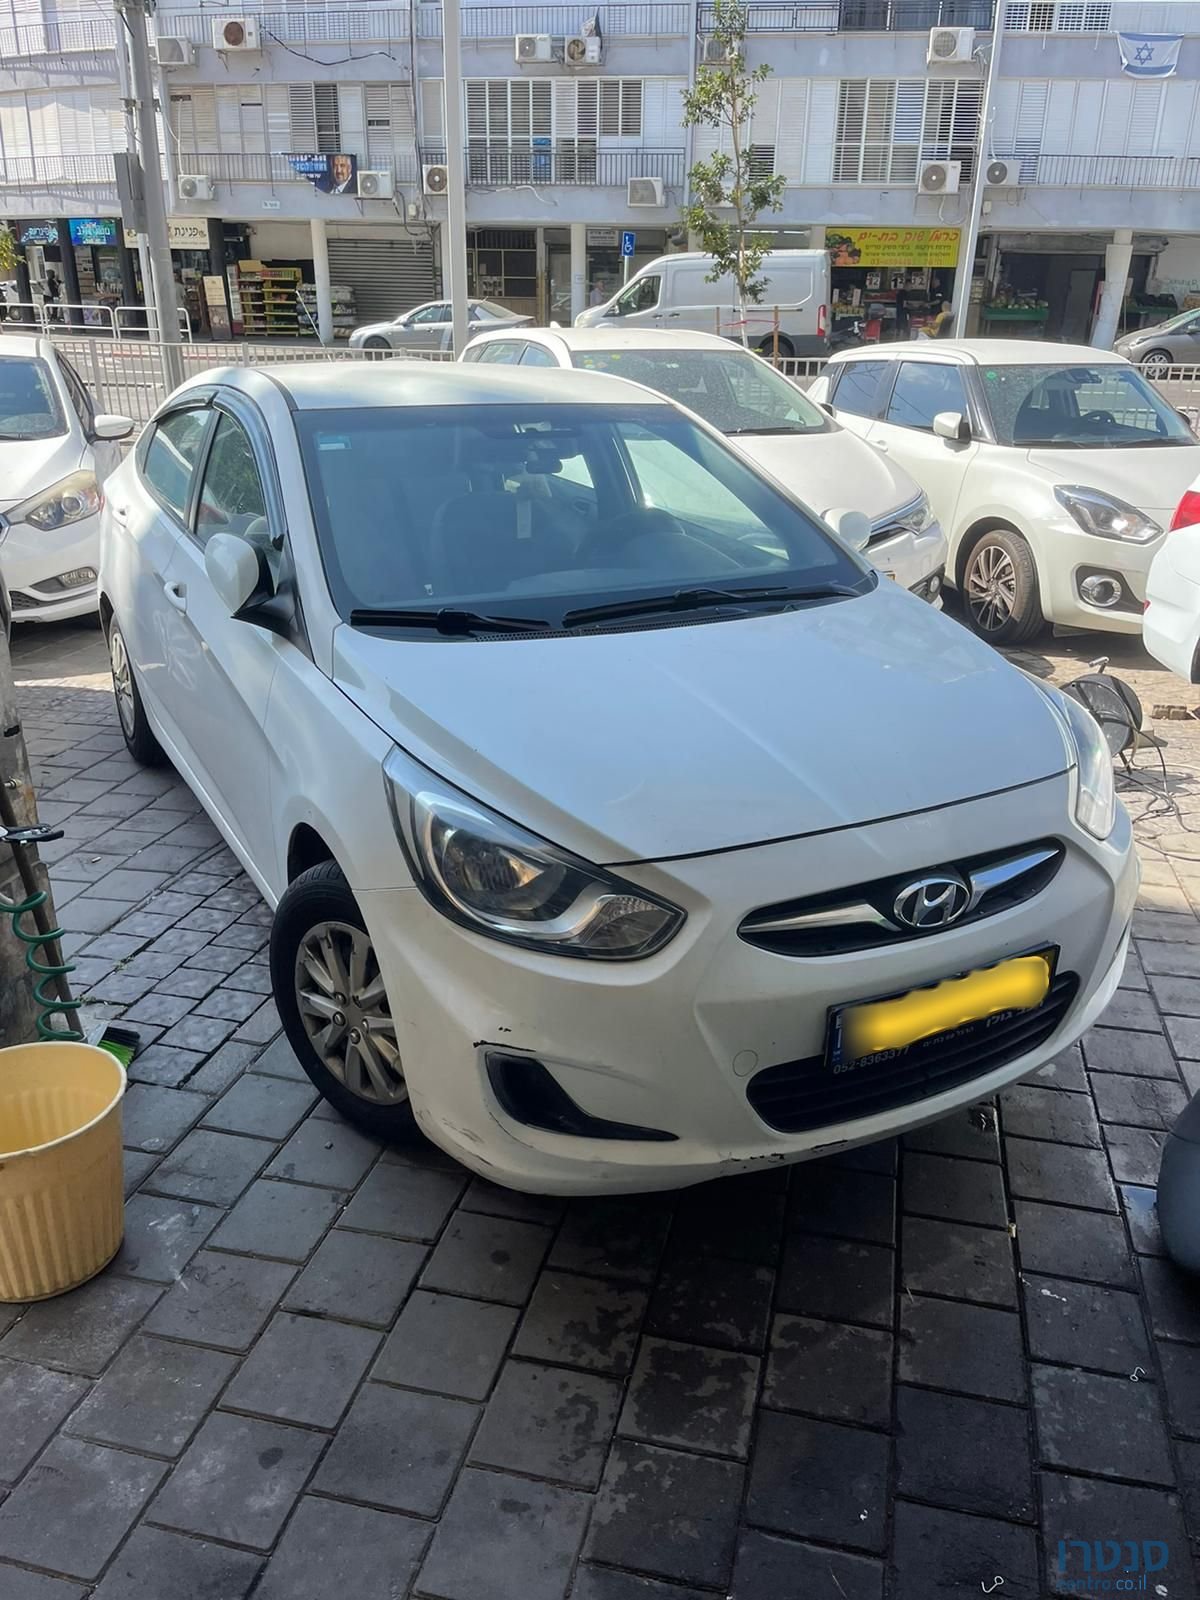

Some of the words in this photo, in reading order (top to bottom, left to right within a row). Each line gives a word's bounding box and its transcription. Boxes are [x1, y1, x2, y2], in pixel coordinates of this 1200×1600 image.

[858, 232, 898, 242] בת-ים
[903, 231, 924, 243] שוק
[928, 230, 958, 241] כרמל
